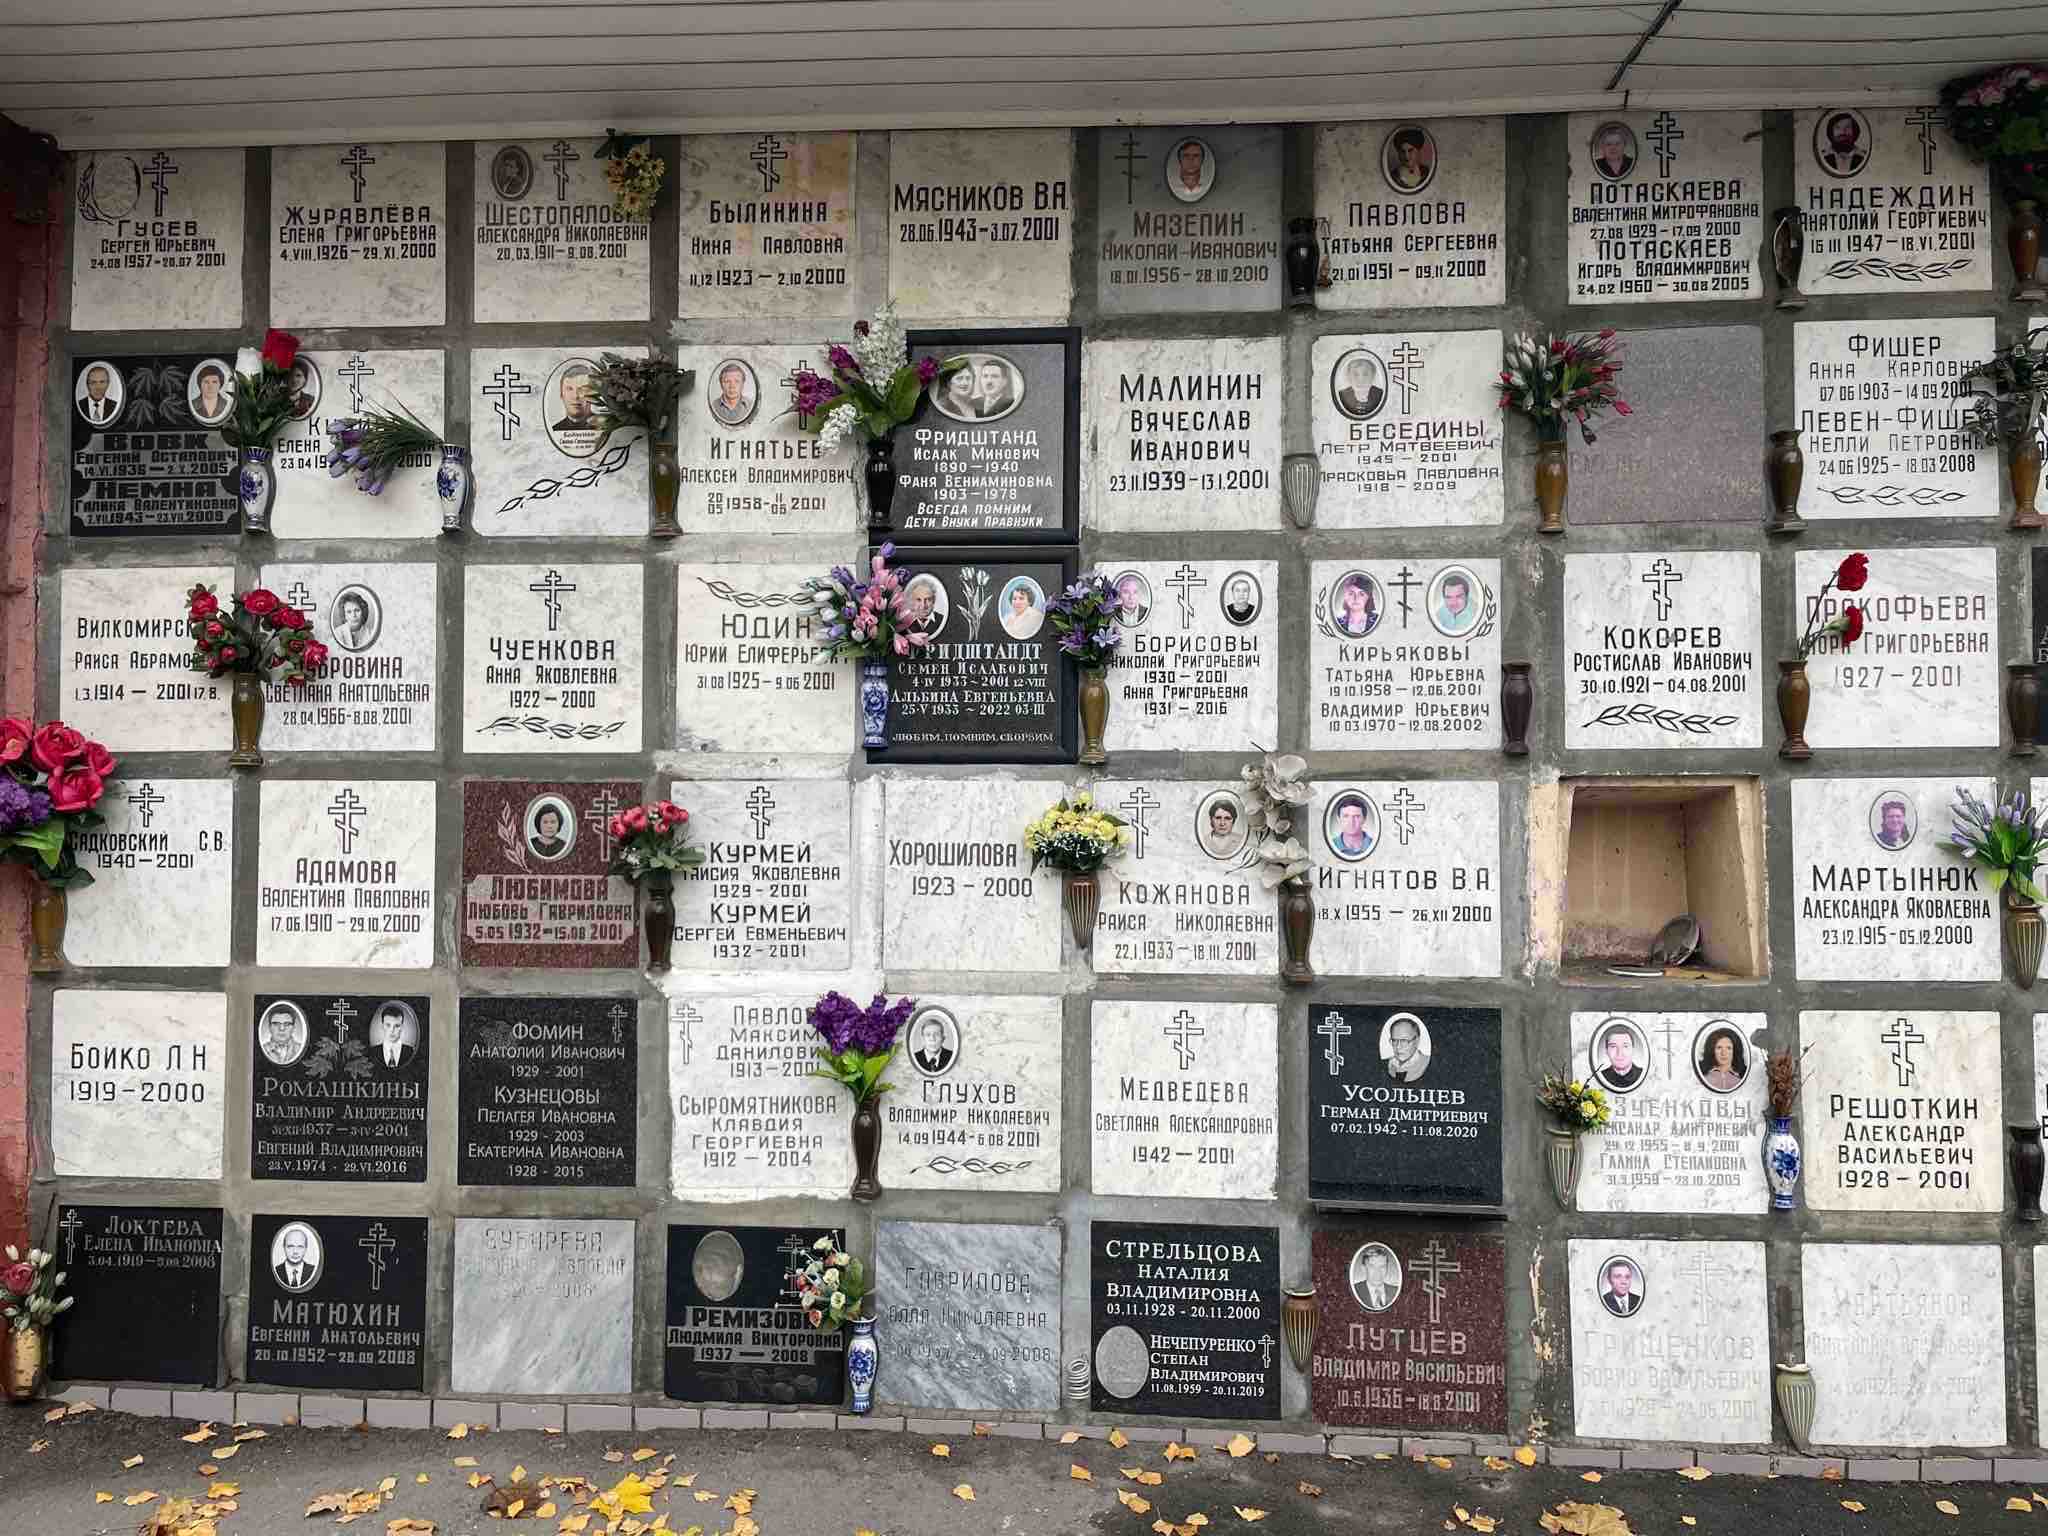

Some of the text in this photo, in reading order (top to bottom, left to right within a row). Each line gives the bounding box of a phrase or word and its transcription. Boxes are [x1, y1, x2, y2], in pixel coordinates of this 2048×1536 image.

[894, 182, 1024, 212] МЯСНИКОВ
[1589, 179, 1743, 205] ПОТАСКАЕВА
[1808, 184, 1975, 211] НАДЕЖДИН
[285, 205, 432, 225] ЖУРАВЛЁВА
[709, 200, 828, 225] БЫЛИНИНА
[1348, 201, 1466, 228] ПАВЛОВА
[1571, 202, 1760, 224] ВАЛЕНТИНА МИТРОФАНОВНА
[1887, 209, 1987, 230] ГЕОРГИЕВИЧ
[116, 219, 198, 238] ГУСЕВ
[279, 223, 437, 244] ЕЛЕНА ГРИГОРЬЕВНА
[476, 225, 649, 244] АЛЕКСАНДРА НИКОЛАЕВНА
[1132, 211, 1244, 238] МАЗЕПИН
[155, 238, 216, 253] ЮРЬЕВИЧ
[691, 235, 844, 256] НИНА ПАВЛОВНА
[1403, 233, 1498, 253] СЕРГЕЕВНА
[1598, 239, 1733, 261] ПОТАСКАЕВ
[1577, 260, 1751, 280] ИГОРЬ ВЛАДИМИРОВИЧ
[1847, 333, 1941, 359] ФИШЕР
[1808, 361, 1856, 380] АННА
[1119, 373, 1263, 402] МАЛИНИН
[1130, 409, 1251, 433] ВЯЧЕСЛАВ
[1349, 419, 1486, 442] БЕСЕДИНЫ
[277, 437, 321, 454] ЕЛЕНА
[914, 429, 1039, 446] ФРИДШТАНД
[1320, 438, 1496, 455] ПЕТР МАТВЕЕВИЧ
[1809, 435, 1870, 453] НЕЛЛИ
[912, 446, 1041, 461] ИСААК МИНОВИЧ
[1130, 438, 1251, 462] ИВАНОВИЧ
[747, 465, 854, 485] ВЛАДИМИРОВИЧ
[899, 473, 1054, 489] ФАНЯ ВЕНИАМИНОВНА
[1416, 465, 1499, 480] ПАВЛОВНА
[917, 502, 1032, 515] ВСЕГДА ПОМНИМ
[903, 515, 1044, 529] ДЕТИ ВНУКИ ПРАВНУКИ
[1134, 634, 1259, 654] БОРИСОВЫ
[1603, 625, 1722, 650] КОКОРЕВ
[1864, 631, 1989, 655] ГРИГОРЬЕВНА
[489, 637, 616, 661] ЧУЕНКОВА
[1338, 642, 1470, 663] КИРЬЯКОВЫ
[1173, 653, 1261, 669] ГРИГОРЬЕВИЧ
[1573, 650, 1753, 673] РОСТИСЛАВ ИВАНОВИЧ
[485, 664, 618, 685] АННА ЯКОВЛЕВНА
[1325, 666, 1486, 684] ТАТЬЯНА ЮРЬЕВНА
[1834, 666, 1885, 689] 1927
[1911, 664, 1962, 688] 2001
[265, 683, 430, 704] СВЕТЛАНА АНАТОЛЬЕВНА
[889, 689, 1056, 705] АЛЬБИНА ЕВГЕНЬЕВНА
[1123, 684, 1249, 700] АННА ГРИГОРЬЕВНА
[1320, 701, 1490, 720] ВЛАДИМИР ЮРЬЕВИЧ
[709, 841, 812, 864] КУРМЕЙ
[888, 839, 1017, 867] ХОРОШИЛОВА
[295, 856, 397, 885] АДАМОВА
[751, 865, 840, 881] ЯКОВЛЕВНА
[1318, 866, 1438, 890] ИГНАТОВ
[1812, 865, 1979, 893] МАРТЫНЮК
[261, 887, 431, 909] ВАЛЕНТИНА ПАВЛОВНА
[489, 877, 609, 900] ЛЮБИМОВА
[1119, 881, 1251, 906] КОЖАНОВА
[467, 902, 632, 922] ЛЮБОВЬ ГАВРИЛОВНА
[709, 902, 811, 924] КУРМЕЙ
[1802, 897, 1992, 921] АЛЕКСАНДРА ЯКОВЛЕВНА
[1174, 912, 1274, 933] НИКОЛАЕВНА
[673, 925, 847, 942] СЕРГЕЙ ЕВМЕНЬЕВИЧ
[512, 1023, 584, 1041] ФОМИН
[470, 1044, 626, 1061] АНАТОЛИЙ ИВАНОВИЧ
[261, 1077, 421, 1100] РОМАШКИНЫ
[493, 1086, 601, 1106] КУЗНЕЦОВЫ
[921, 1080, 1017, 1105] ГЛУХОВ
[1119, 1075, 1250, 1104] МЕДВЕДЕВА
[1341, 1085, 1466, 1108] УСОЛЬЦЕВ
[254, 1103, 425, 1122] ВЛАДИМИР АНДРЕЕВИЧ
[679, 1094, 837, 1116] СЫРОМЯТНИКОВА
[1319, 1104, 1489, 1126] ГЕРМАН ДМИТРИЕВИЧ
[1830, 1094, 1979, 1120] РЕШОТКИН
[477, 1108, 616, 1125] ПЕЛАГЕЯ ИВАНОВНА
[711, 1118, 804, 1132] КЛАВДИЯ
[888, 1106, 1051, 1127] ВЛАДИМИР НИКОЛАЕВИЧ
[1095, 1113, 1273, 1137] СВЕТЛАНА АЛЕКСАНДРОВНА
[1330, 1121, 1399, 1136] 07.02.1942
[1412, 1125, 1479, 1140] 11.08.2020
[1843, 1121, 1965, 1145] АЛЕКСАНДР
[257, 1141, 424, 1159] ЕВГЕНИЙ ВЛАДИМИРОВИЧ
[468, 1143, 625, 1160] ЕКАТЕРИНА ИВАНОВНА
[691, 1134, 823, 1151] ГЕОРГИЕВНА
[1837, 1146, 1974, 1165] ВАСИЛЬЕВИЧ
[1837, 1170, 1890, 1188] 1928
[1919, 1170, 1970, 1189] 2001
[104, 1215, 204, 1237] ЛОКТЕВА
[83, 1234, 223, 1254] ЕЛЕНА ИВАНОВНА
[1105, 1239, 1262, 1265] СТРЕЛЬЦОВА
[1138, 1264, 1230, 1282] НАТАЛИЯ
[1106, 1282, 1261, 1304] ВЛАДИМИРОВНА
[272, 1299, 401, 1328] МАТЮХИН
[1106, 1302, 1176, 1318] 03.11.1928
[1190, 1304, 1261, 1321] 20.11.2000
[320, 1328, 421, 1347] АНАТОЛЬЕВИЧ
[669, 1330, 842, 1349] ЛЮДМИЛА ВИКТОРОВНА
[1150, 1334, 1256, 1353] НЕЧЕПУРЕНКО
[1150, 1351, 1209, 1367] СТЕПАН
[1312, 1355, 1401, 1382] ВЛАДИМИР
[1150, 1368, 1265, 1384] ВЛАДИМИРОВИЧ
[1150, 1382, 1202, 1396] 11.08.1959
[1212, 1384, 1265, 1398] 20.11.2019
